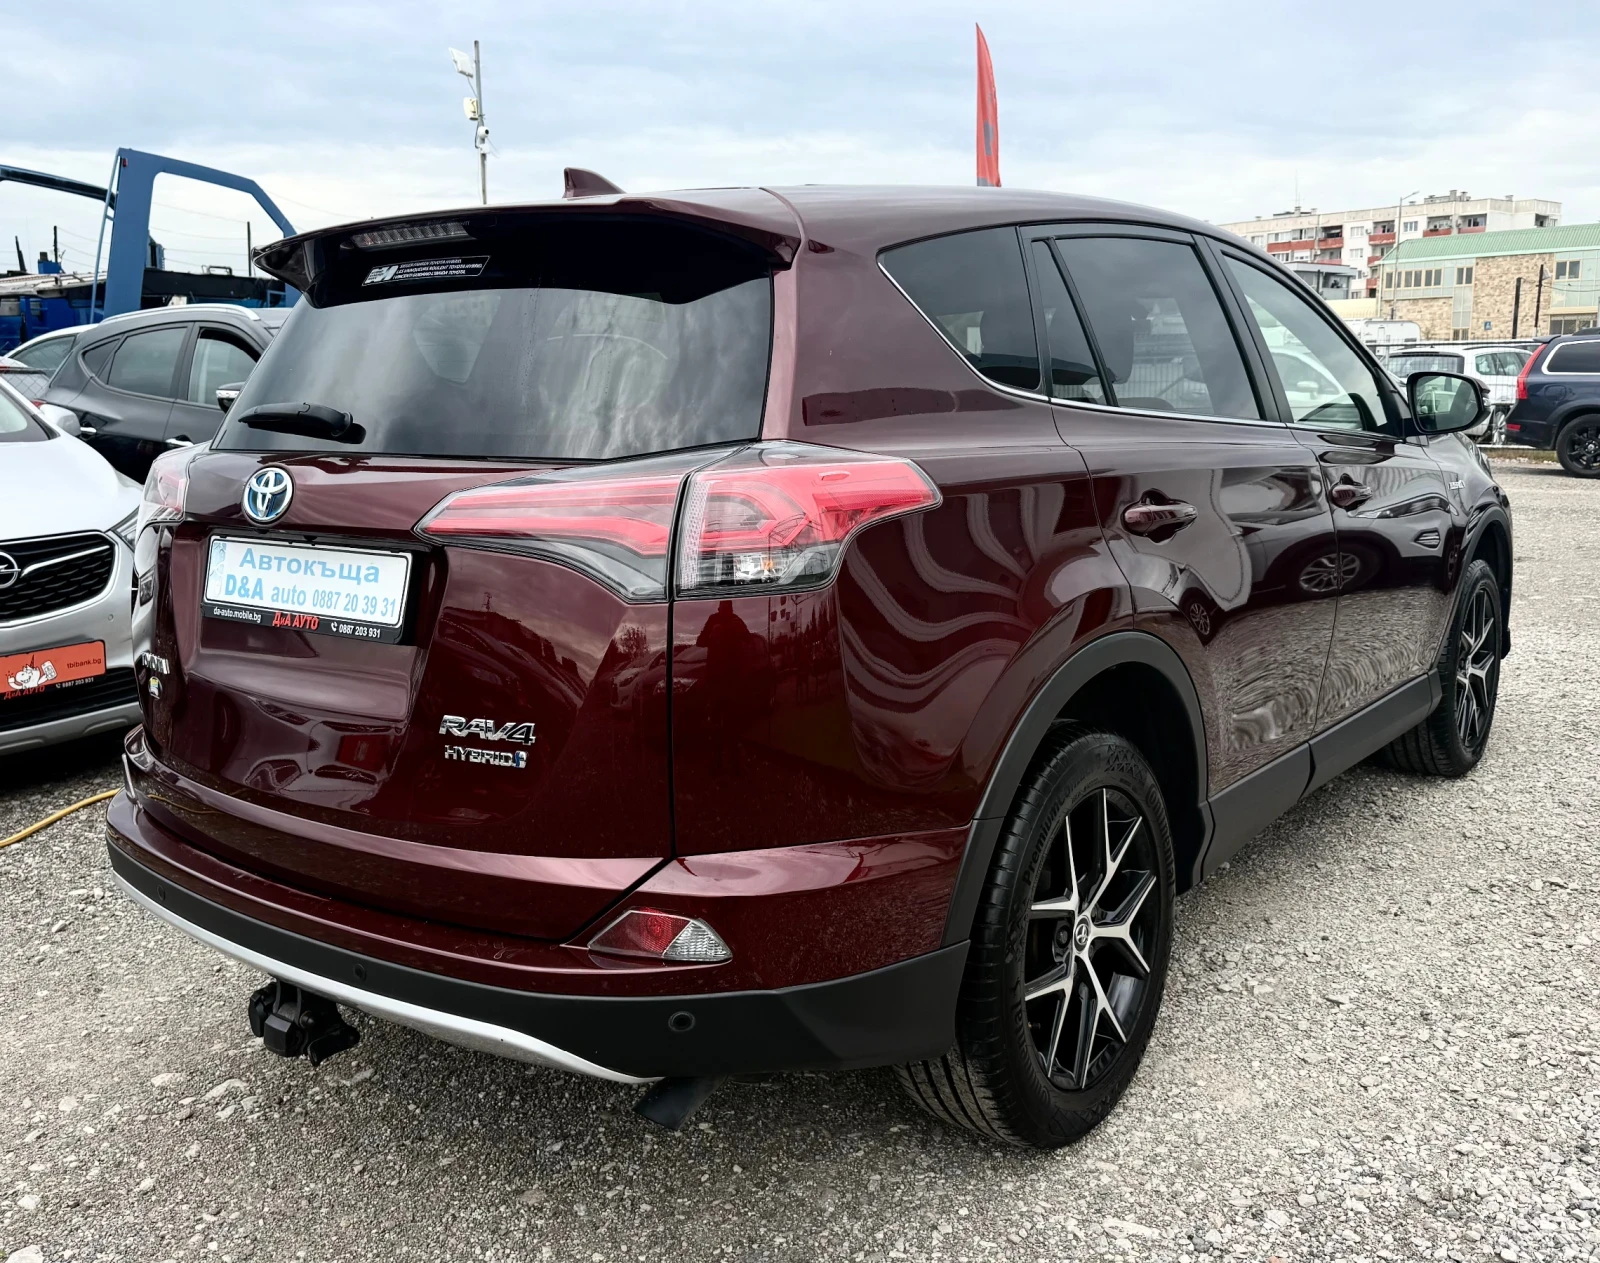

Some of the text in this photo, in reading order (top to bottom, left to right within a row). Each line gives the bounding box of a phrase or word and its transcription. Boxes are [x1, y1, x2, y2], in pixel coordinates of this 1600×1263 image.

[239, 547, 380, 586] Автокъща
[225, 574, 396, 618] D&A auto 0887 20 39 31
[338, 623, 381, 638] 0887 203 931
[66, 658, 102, 669] tbibank.bg
[439, 714, 536, 746] RAV4
[444, 745, 513, 766] HYBRID
